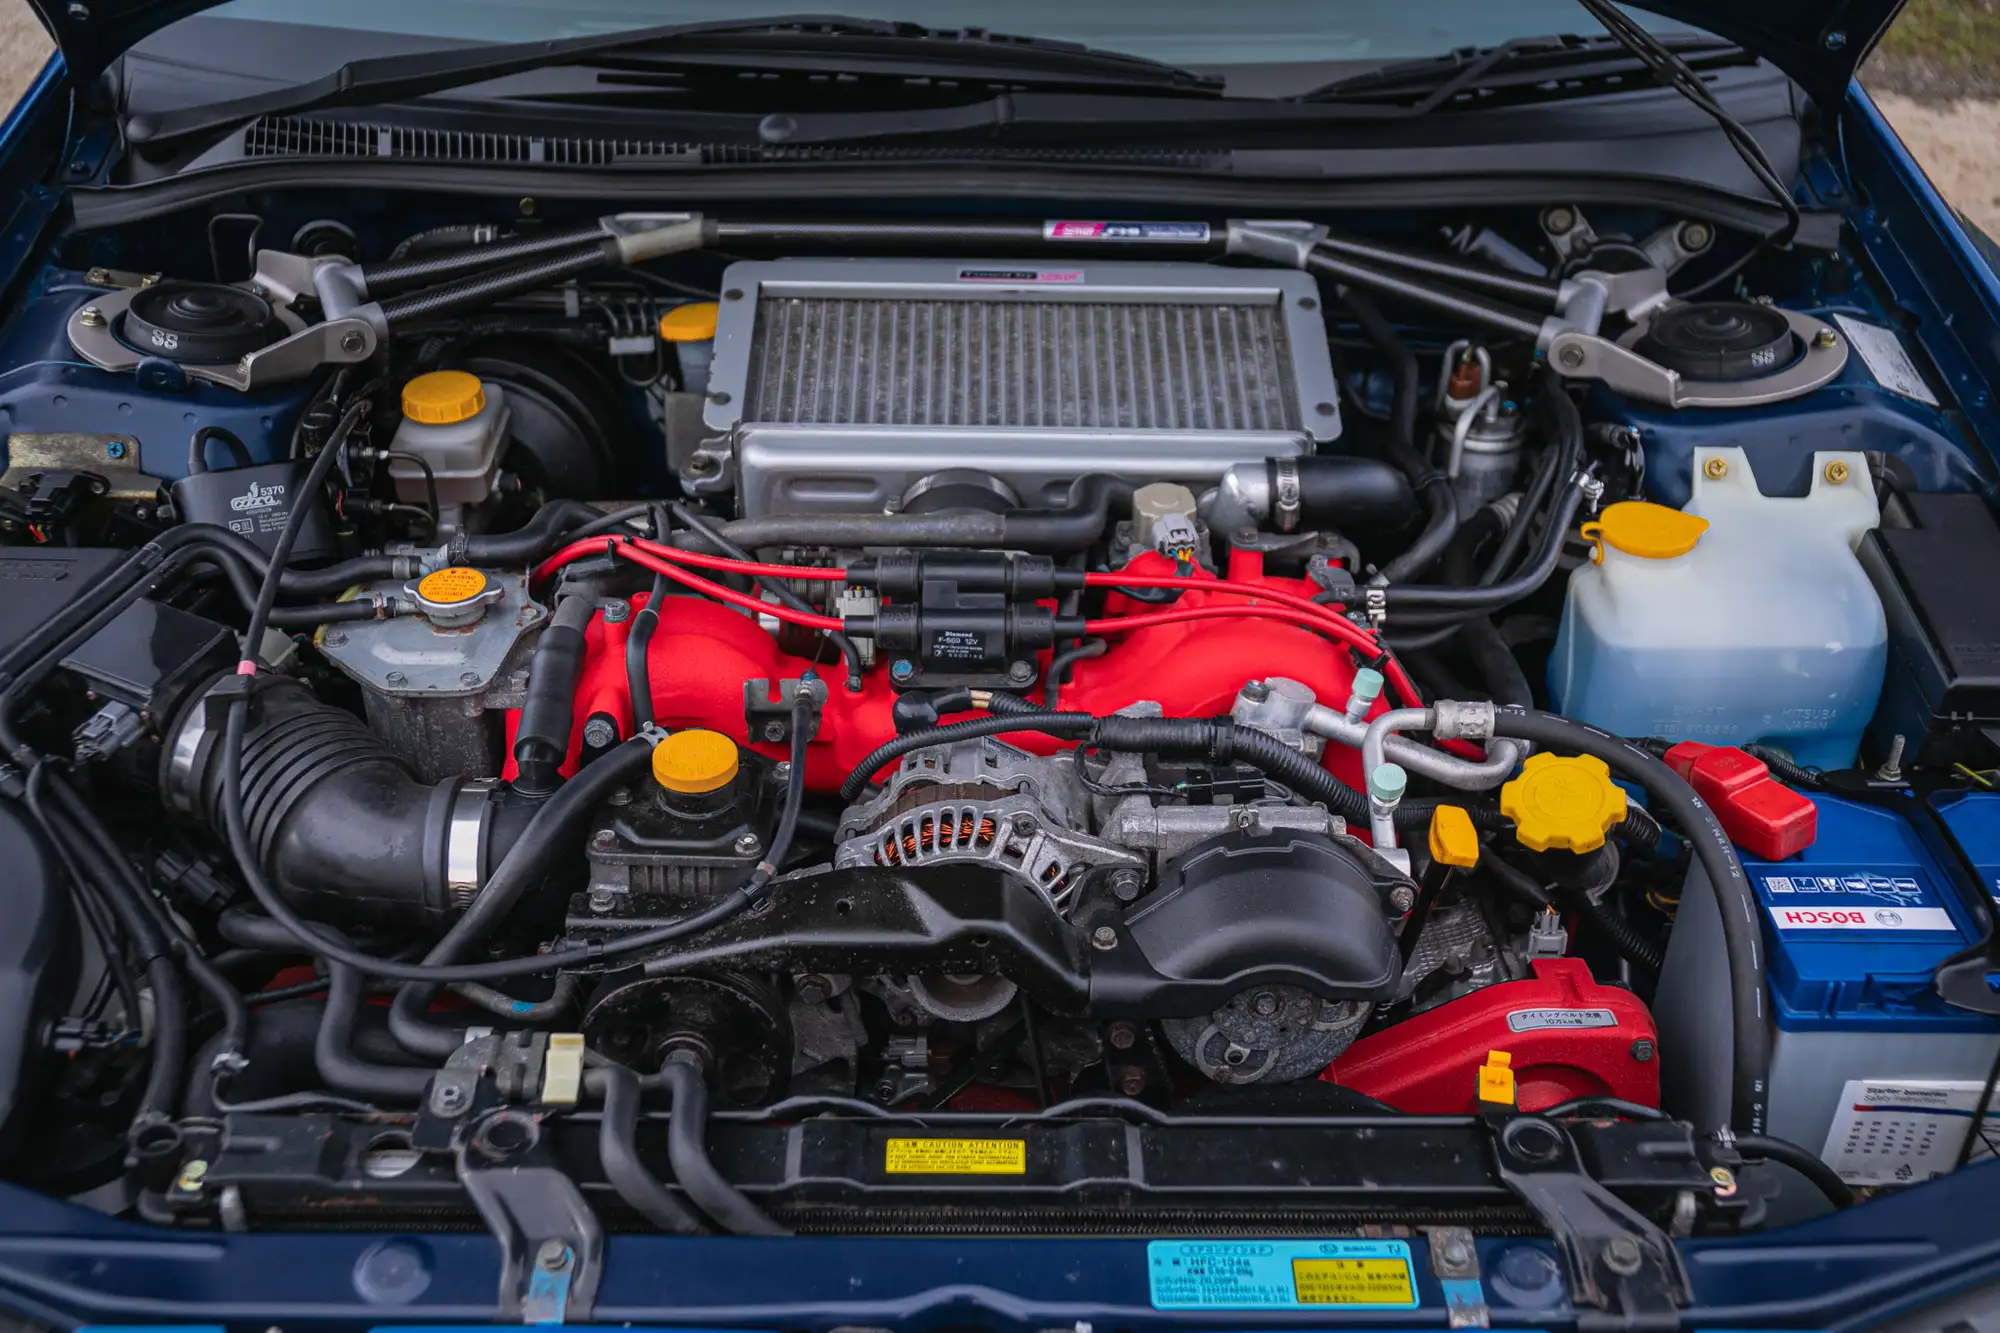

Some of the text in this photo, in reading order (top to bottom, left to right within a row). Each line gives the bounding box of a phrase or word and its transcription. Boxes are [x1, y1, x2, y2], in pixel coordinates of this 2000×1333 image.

[260, 484, 285, 496] 5370
[1781, 708, 1837, 719] MITSUBA
[1786, 721, 1828, 731] JAPAN
[1785, 911, 1866, 924] BOSCH
[1865, 1086, 1902, 1095] Starter
